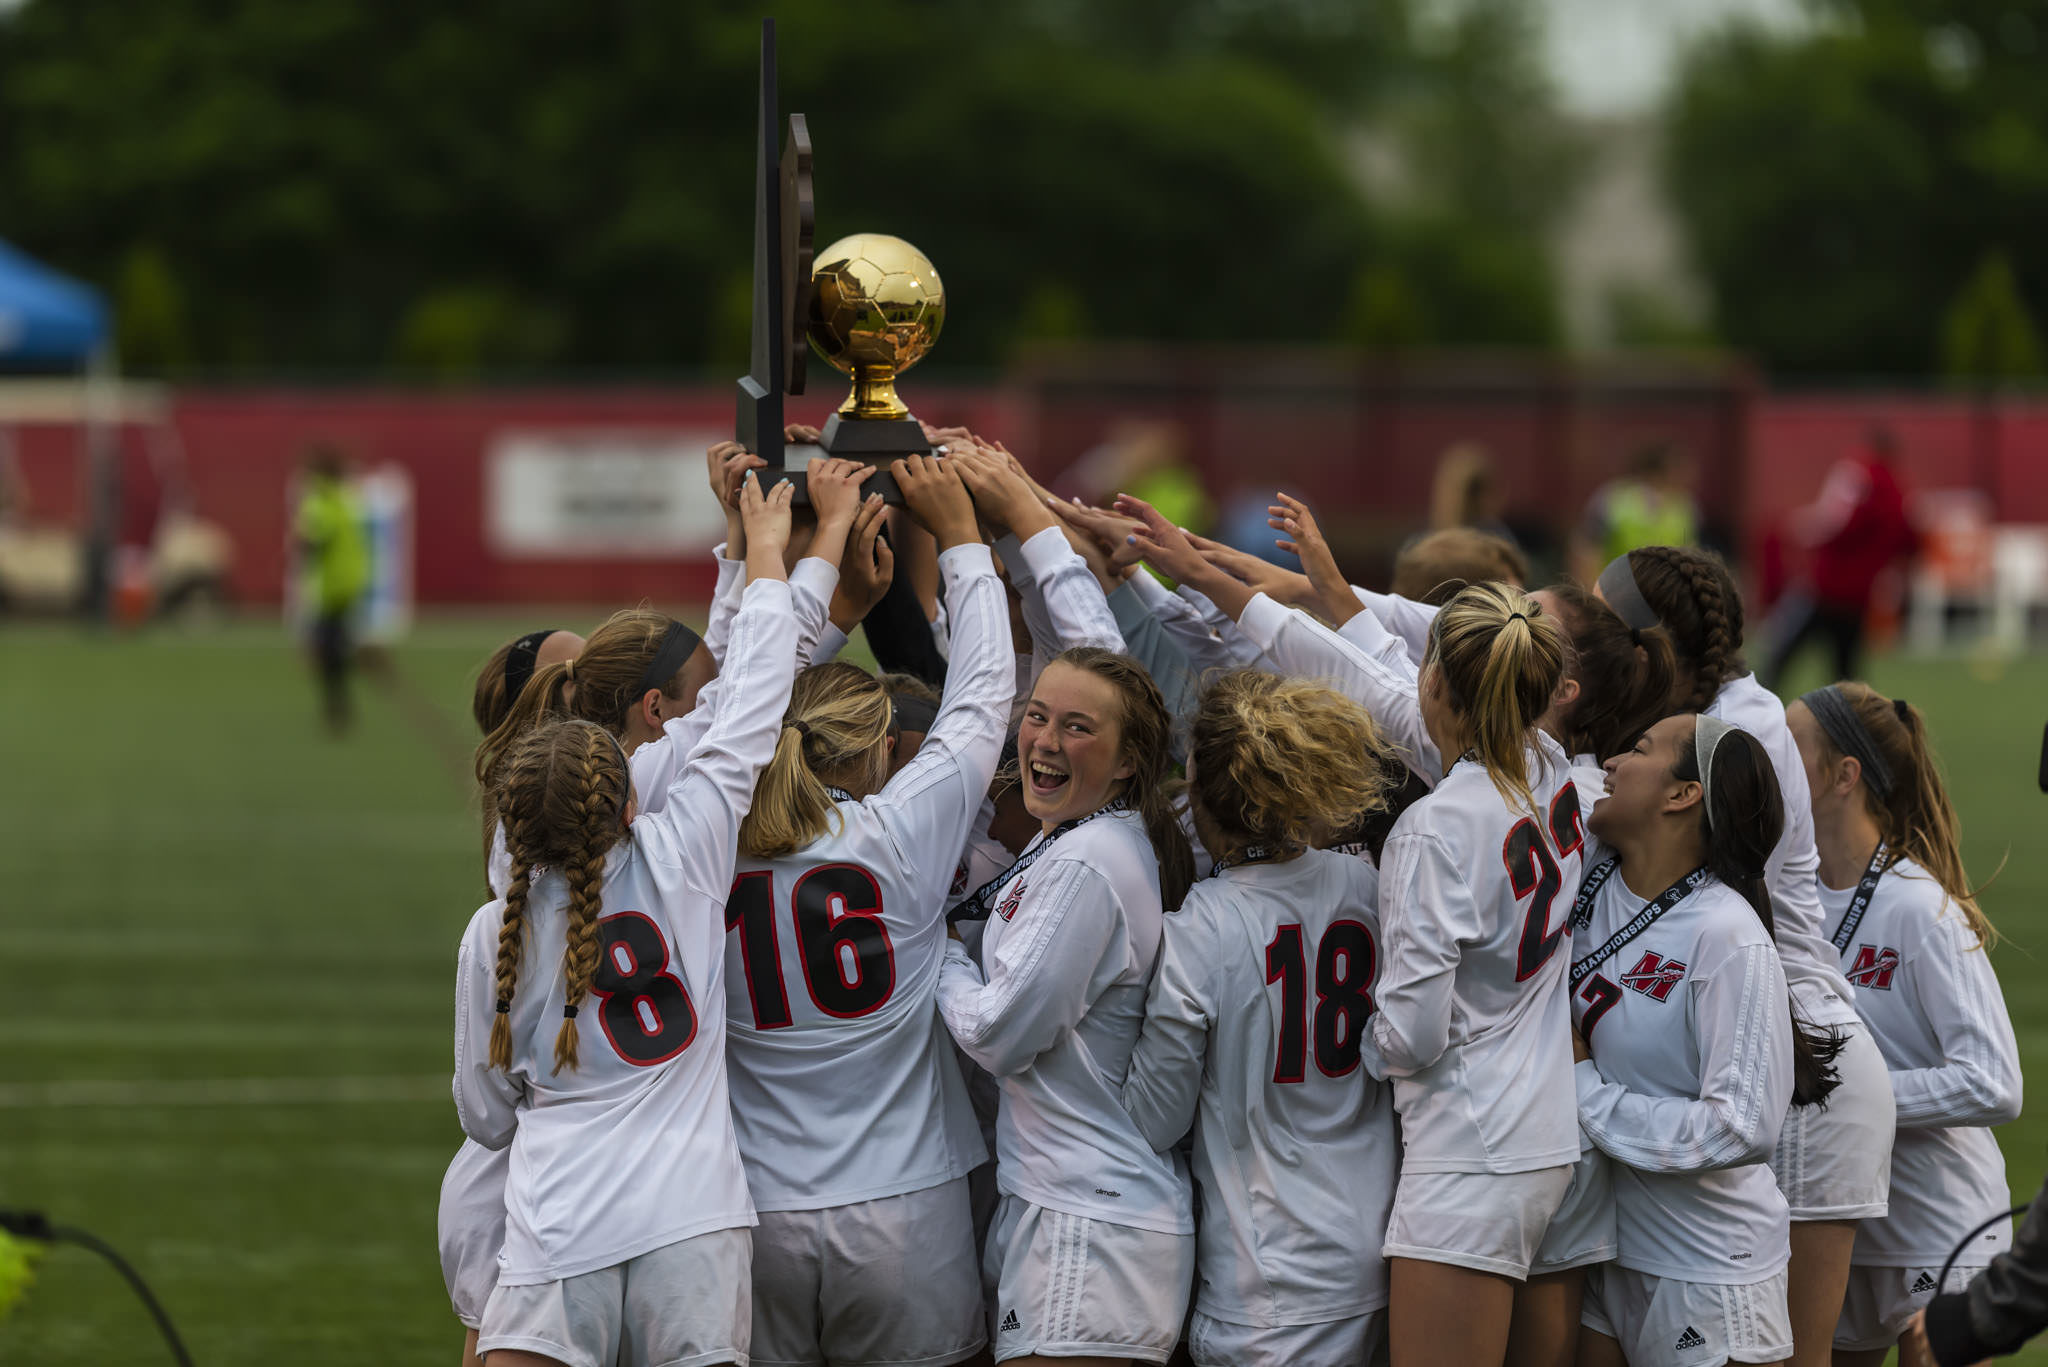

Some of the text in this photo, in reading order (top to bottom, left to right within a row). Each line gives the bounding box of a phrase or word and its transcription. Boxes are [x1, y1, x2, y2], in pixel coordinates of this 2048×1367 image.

[1000, 836, 1057, 887] CHAMPIONSHIPS
[725, 863, 896, 1030] 16
[1572, 902, 1662, 979] CHAMPIONSHIPS
[590, 911, 698, 1067] 8
[1265, 919, 1376, 1083] 18
[1570, 962, 1623, 1050] 7
[1675, 1337, 1706, 1351] adidas
